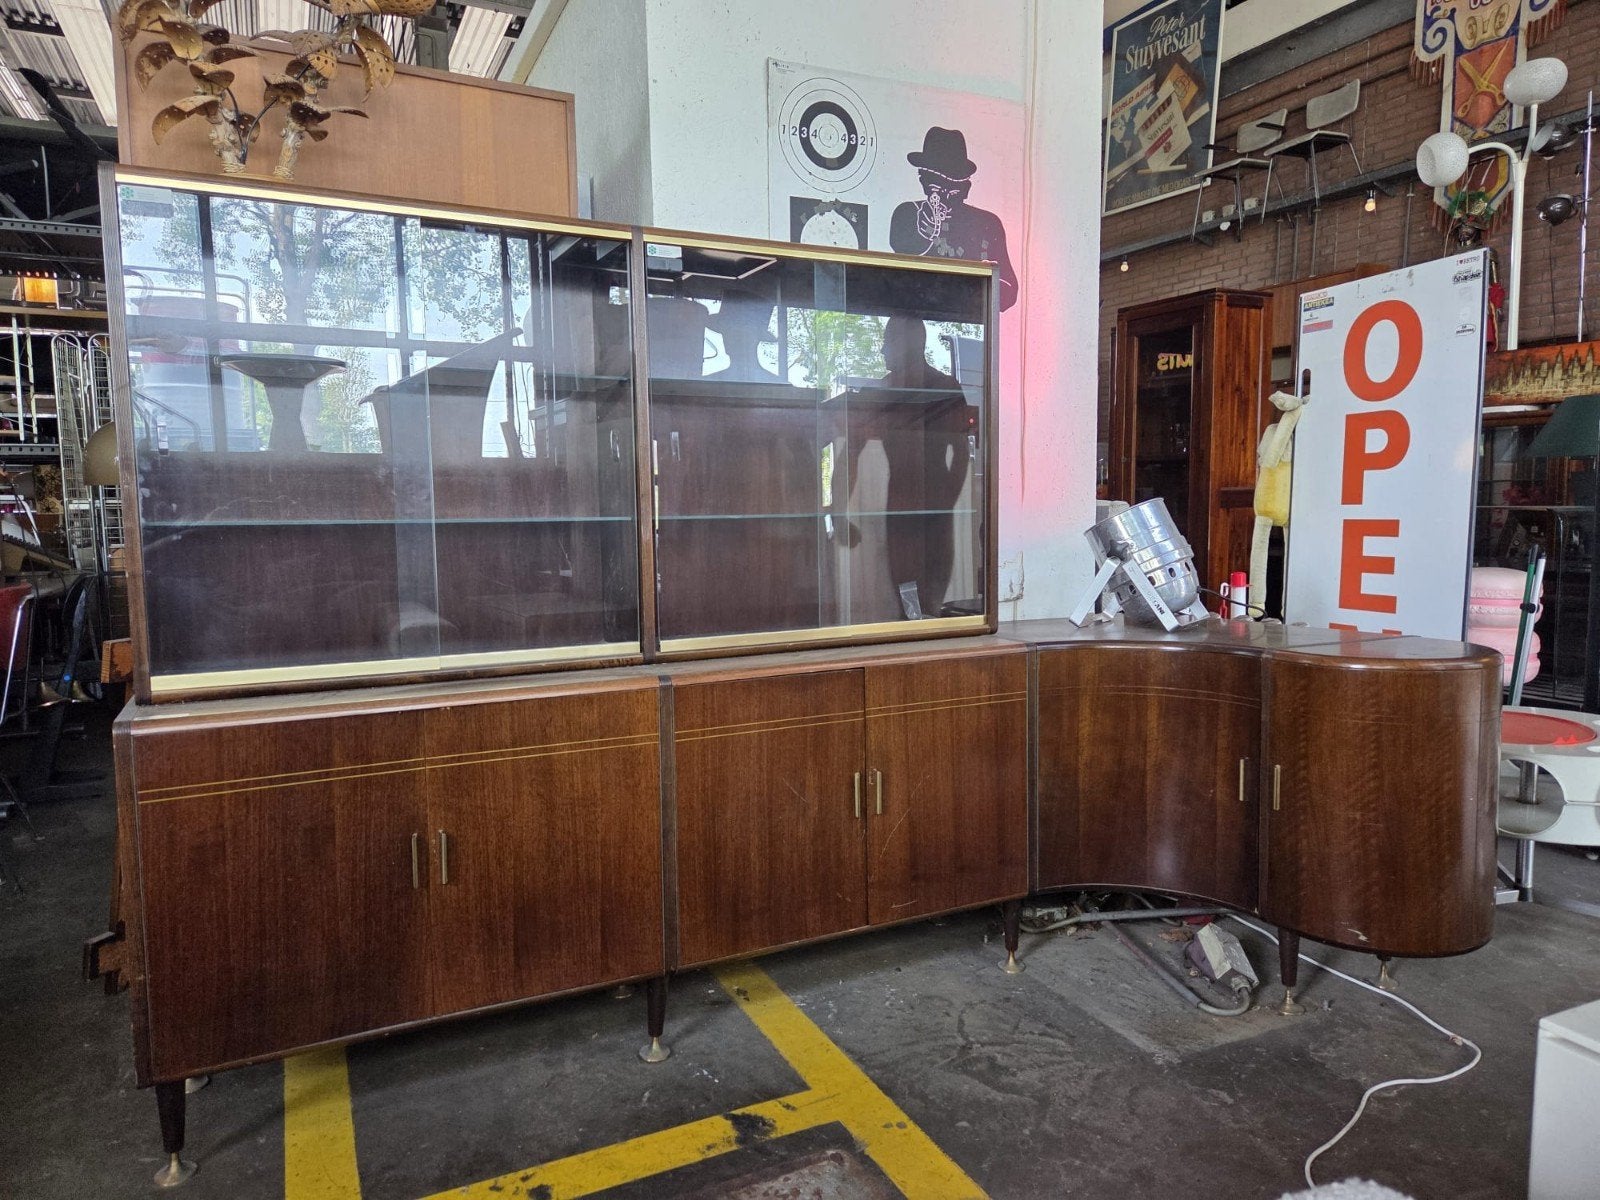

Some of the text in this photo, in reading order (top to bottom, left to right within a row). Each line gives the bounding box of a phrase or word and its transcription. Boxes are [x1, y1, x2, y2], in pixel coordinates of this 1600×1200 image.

[1125, 14, 1206, 74] Stuyvesant
[1147, 11, 1186, 43] Peter
[791, 126, 798, 136] 2
[800, 127, 807, 138] 3
[811, 128, 818, 139] 4
[841, 132, 848, 143] 4
[850, 134, 857, 145] 3
[859, 135, 866, 146] 2
[1328, 299, 1423, 637] OPE
